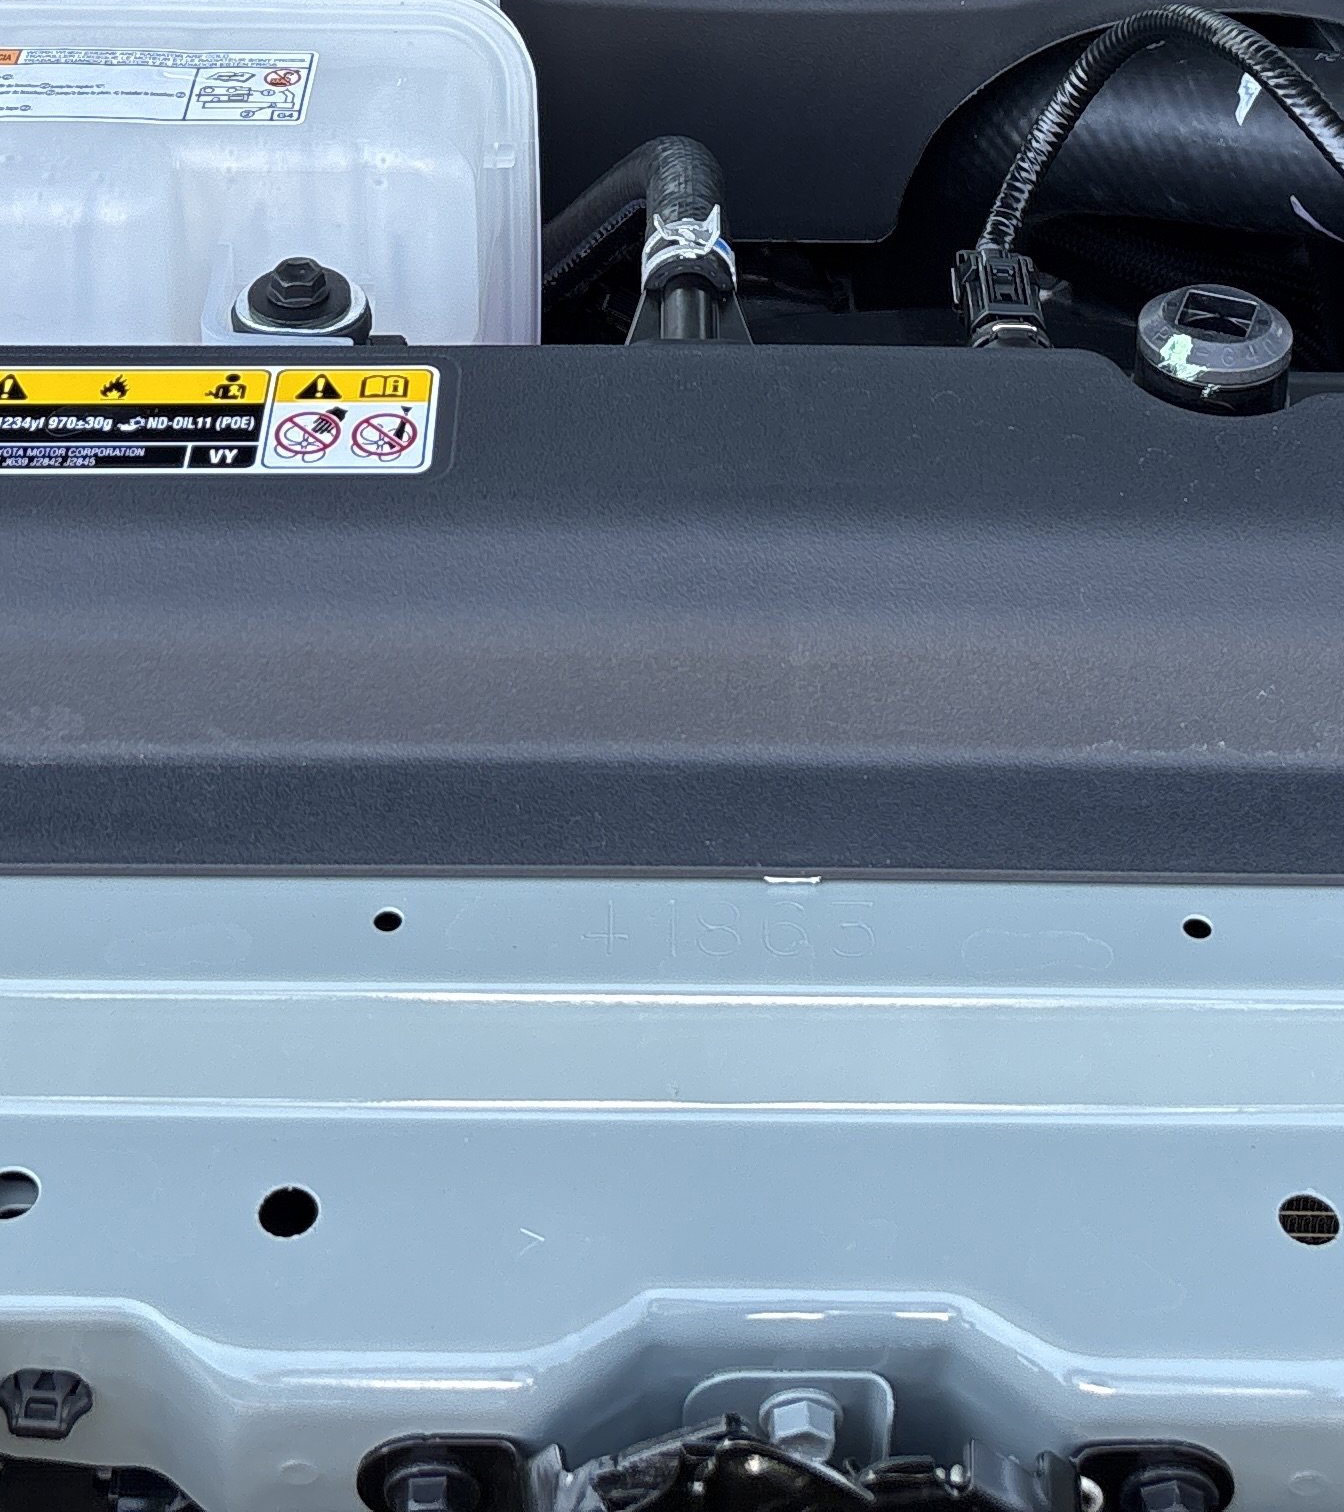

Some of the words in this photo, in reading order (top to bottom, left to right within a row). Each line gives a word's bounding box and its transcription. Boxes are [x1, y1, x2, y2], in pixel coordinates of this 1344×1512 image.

[47, 416, 113, 431] 970±30g
[146, 416, 212, 430] ND-OIL11
[215, 416, 256, 431] (POE)
[26, 448, 66, 457] MOTOR
[68, 448, 145, 457] CORPORATION
[208, 448, 239, 464] VY
